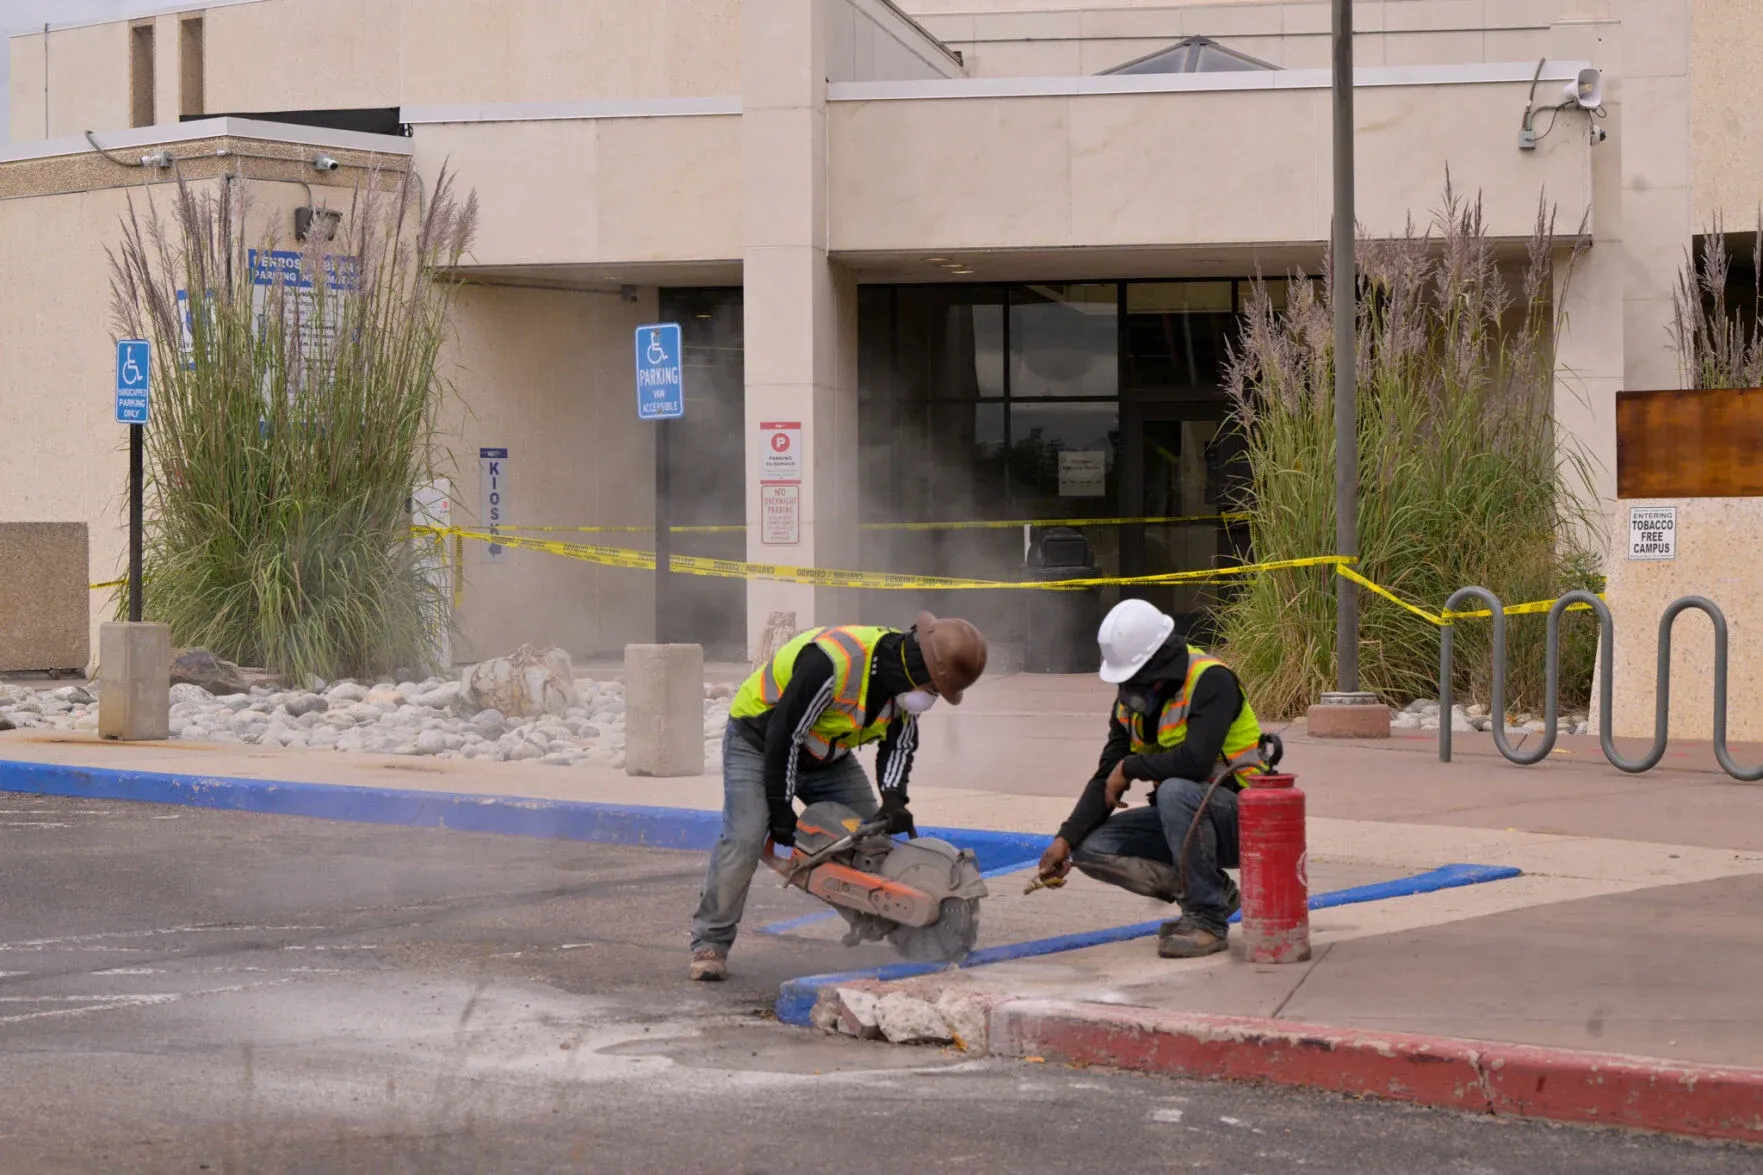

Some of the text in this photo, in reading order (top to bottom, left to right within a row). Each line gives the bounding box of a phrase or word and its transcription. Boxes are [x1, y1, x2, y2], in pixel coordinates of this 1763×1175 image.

[640, 367, 678, 387] PARKING
[653, 389, 665, 398] VAN
[119, 398, 146, 407] PARKING
[642, 401, 679, 412] ACCESSIBLE
[123, 409, 140, 418] ONLY
[776, 437, 786, 448] P
[774, 488, 786, 496] NO
[489, 462, 500, 536] KIOSK
[1632, 520, 1673, 530] TOBACCO
[1641, 532, 1663, 541] FREE
[1633, 543, 1670, 553] CAMPUS
